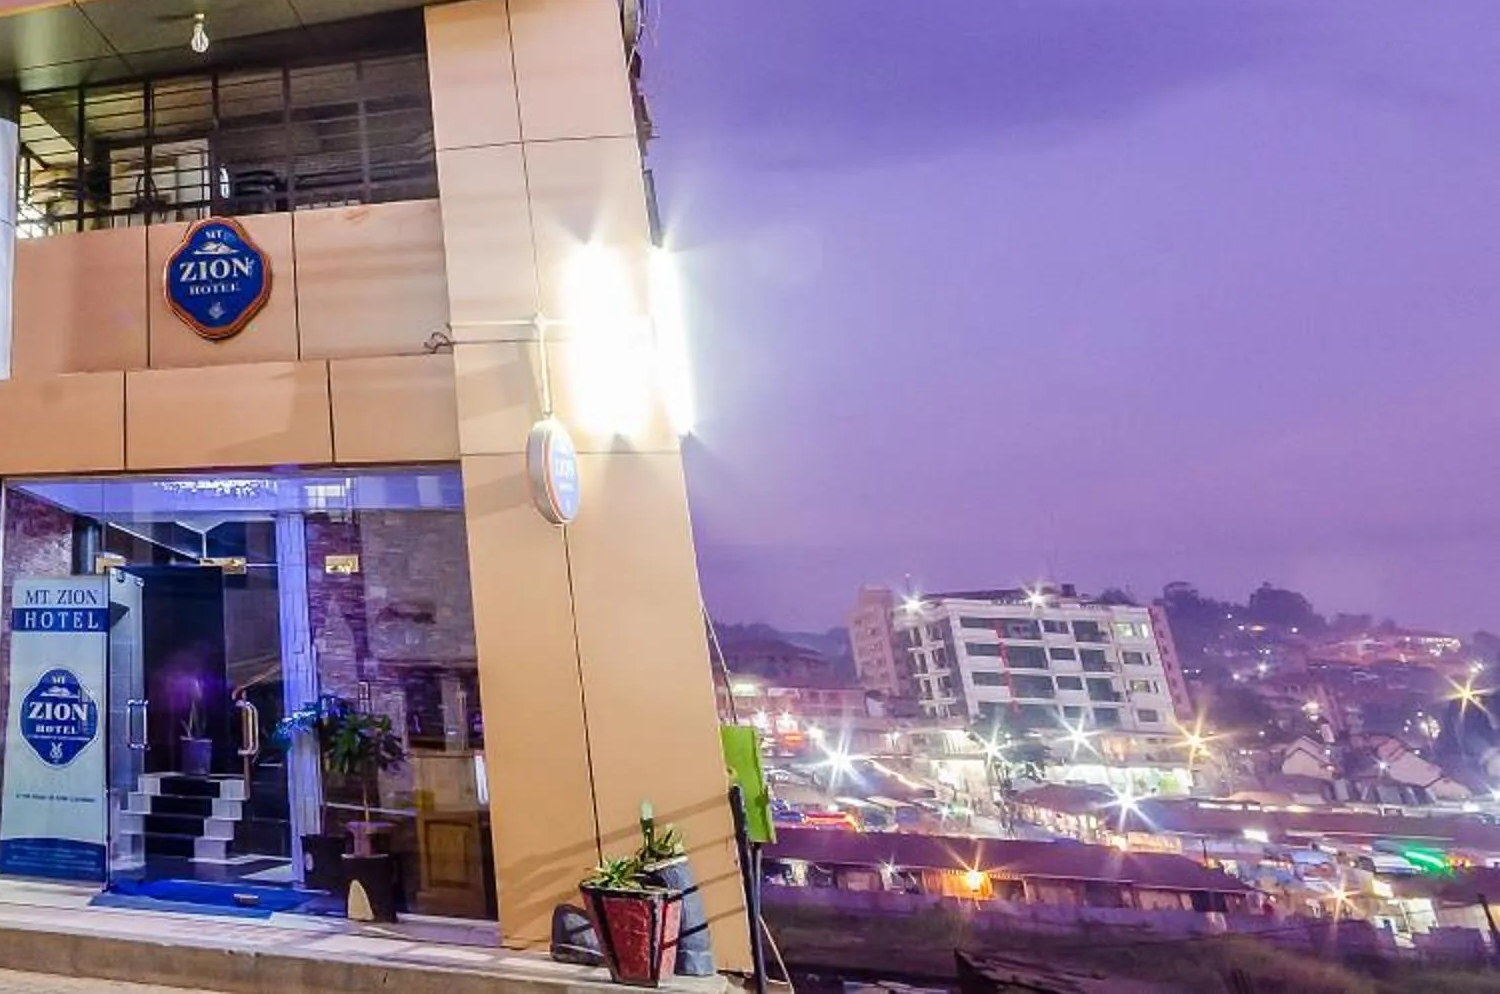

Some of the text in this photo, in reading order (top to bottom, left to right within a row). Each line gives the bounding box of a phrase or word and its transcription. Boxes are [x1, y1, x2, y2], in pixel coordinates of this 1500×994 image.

[180, 257, 252, 283] ZION
[189, 283, 241, 295] HOTEL
[56, 589, 98, 606] ZION
[24, 610, 99, 629] HOTEL
[28, 701, 88, 722] ZION
[35, 724, 79, 735] HOTEL
